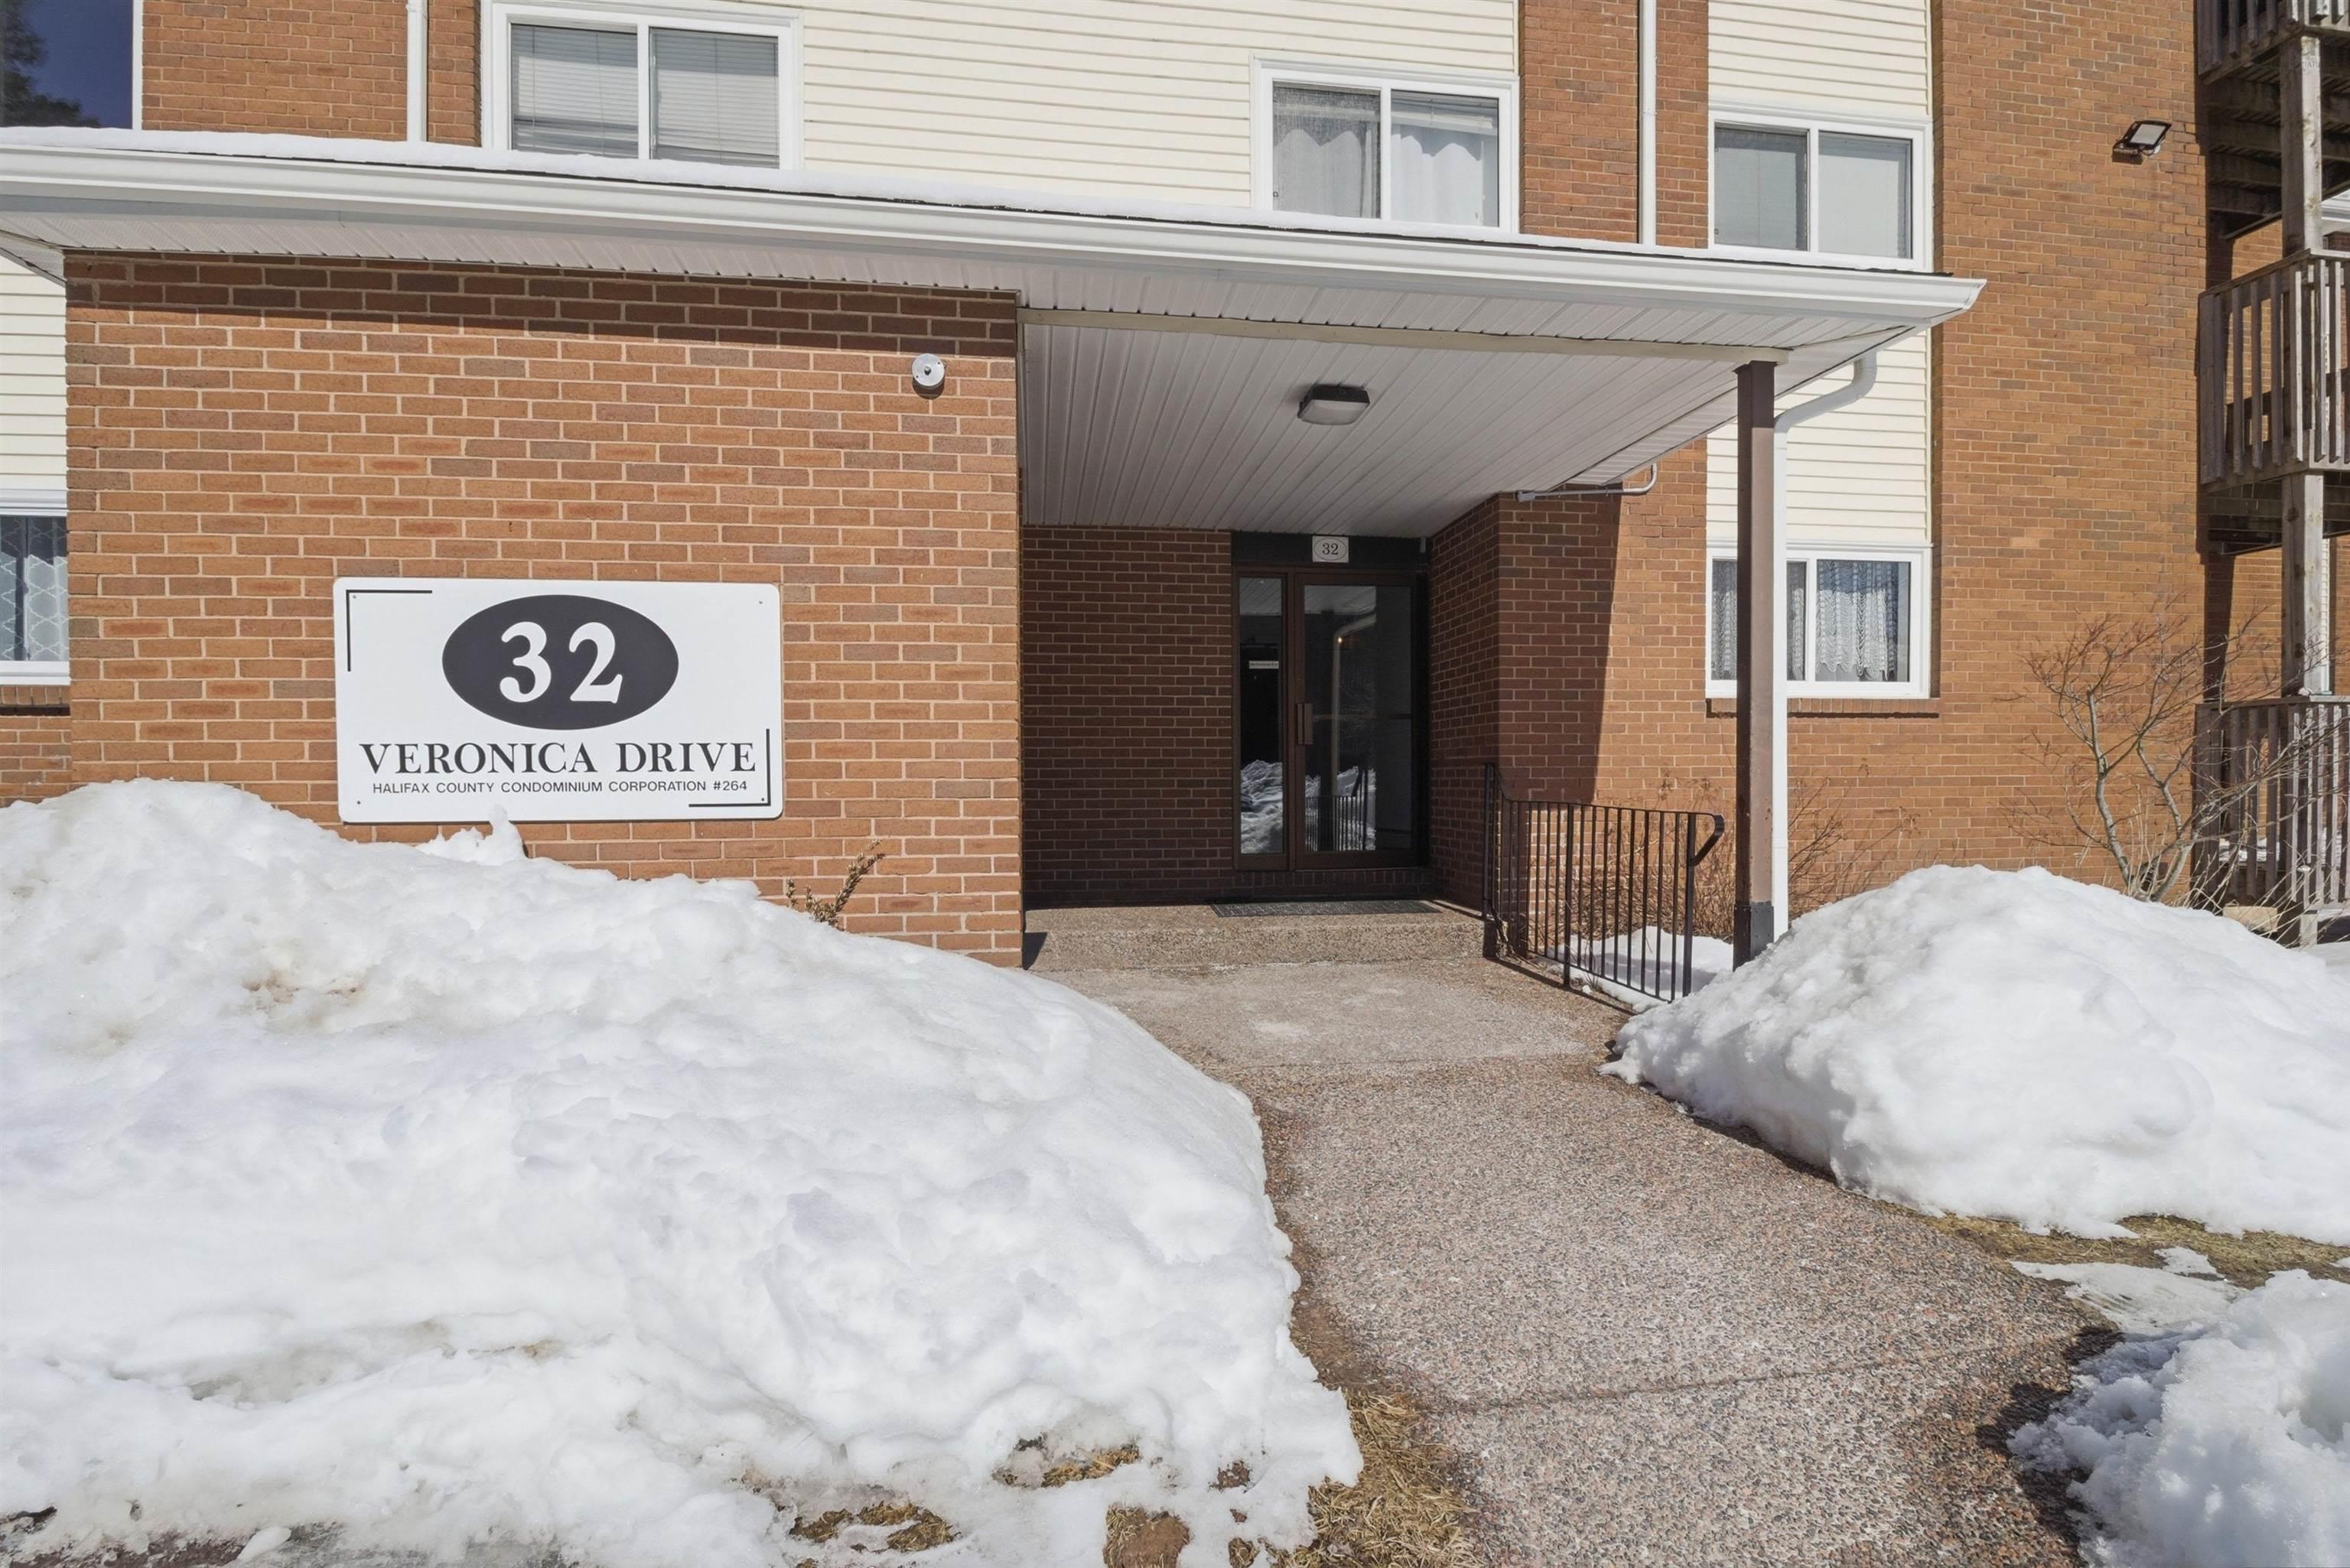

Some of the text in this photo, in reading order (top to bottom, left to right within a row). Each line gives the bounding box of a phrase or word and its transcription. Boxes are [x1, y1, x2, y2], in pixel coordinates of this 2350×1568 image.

[1322, 542, 1339, 555] 32
[500, 621, 623, 704] 32
[359, 742, 757, 775] VERONICA DRIVE
[373, 780, 747, 794] HALIFAX COUNTY CONDOMINIUM CORPORATION #264
